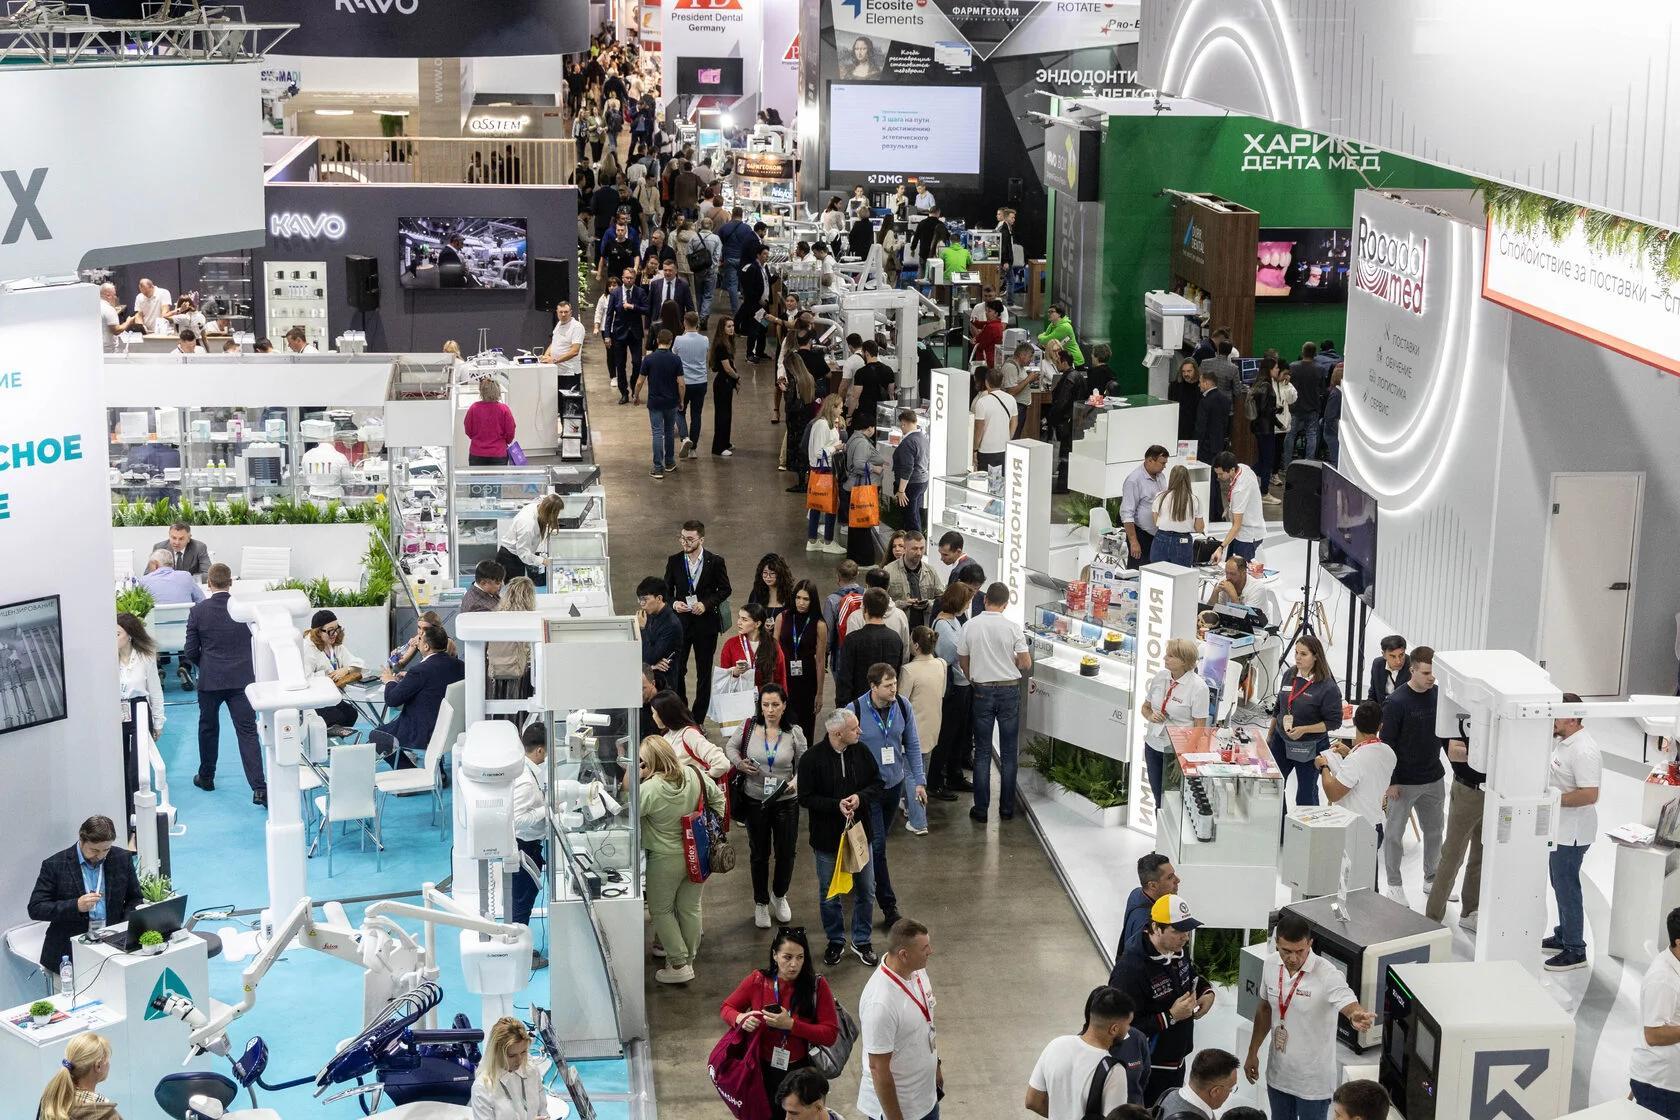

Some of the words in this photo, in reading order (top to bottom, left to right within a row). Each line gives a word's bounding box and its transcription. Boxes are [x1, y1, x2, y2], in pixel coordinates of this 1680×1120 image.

[867, 0, 914, 10] Ecosite
[952, 6, 1019, 16] ФАРМГЕОКОМ
[1057, 2, 1101, 13] ROTATE
[671, 12, 712, 22] President
[715, 13, 743, 22] Dental
[866, 13, 924, 25] Elements
[688, 24, 726, 33] Germany
[1035, 69, 1138, 86] ЭНДОДОНТИ
[472, 119, 521, 130] OSSTEM
[1241, 155, 1322, 171] ДЕНТА
[1328, 156, 1381, 172] МЕД
[878, 174, 903, 184] DMG
[271, 212, 346, 239] KAVO
[1499, 230, 1572, 278] Спокойствие
[1573, 264, 1587, 283] за
[1589, 268, 1648, 304] поставки
[1390, 252, 1427, 315] med
[935, 383, 944, 421] ТОП
[1009, 457, 1023, 606] ОРТОДОНТИЯ
